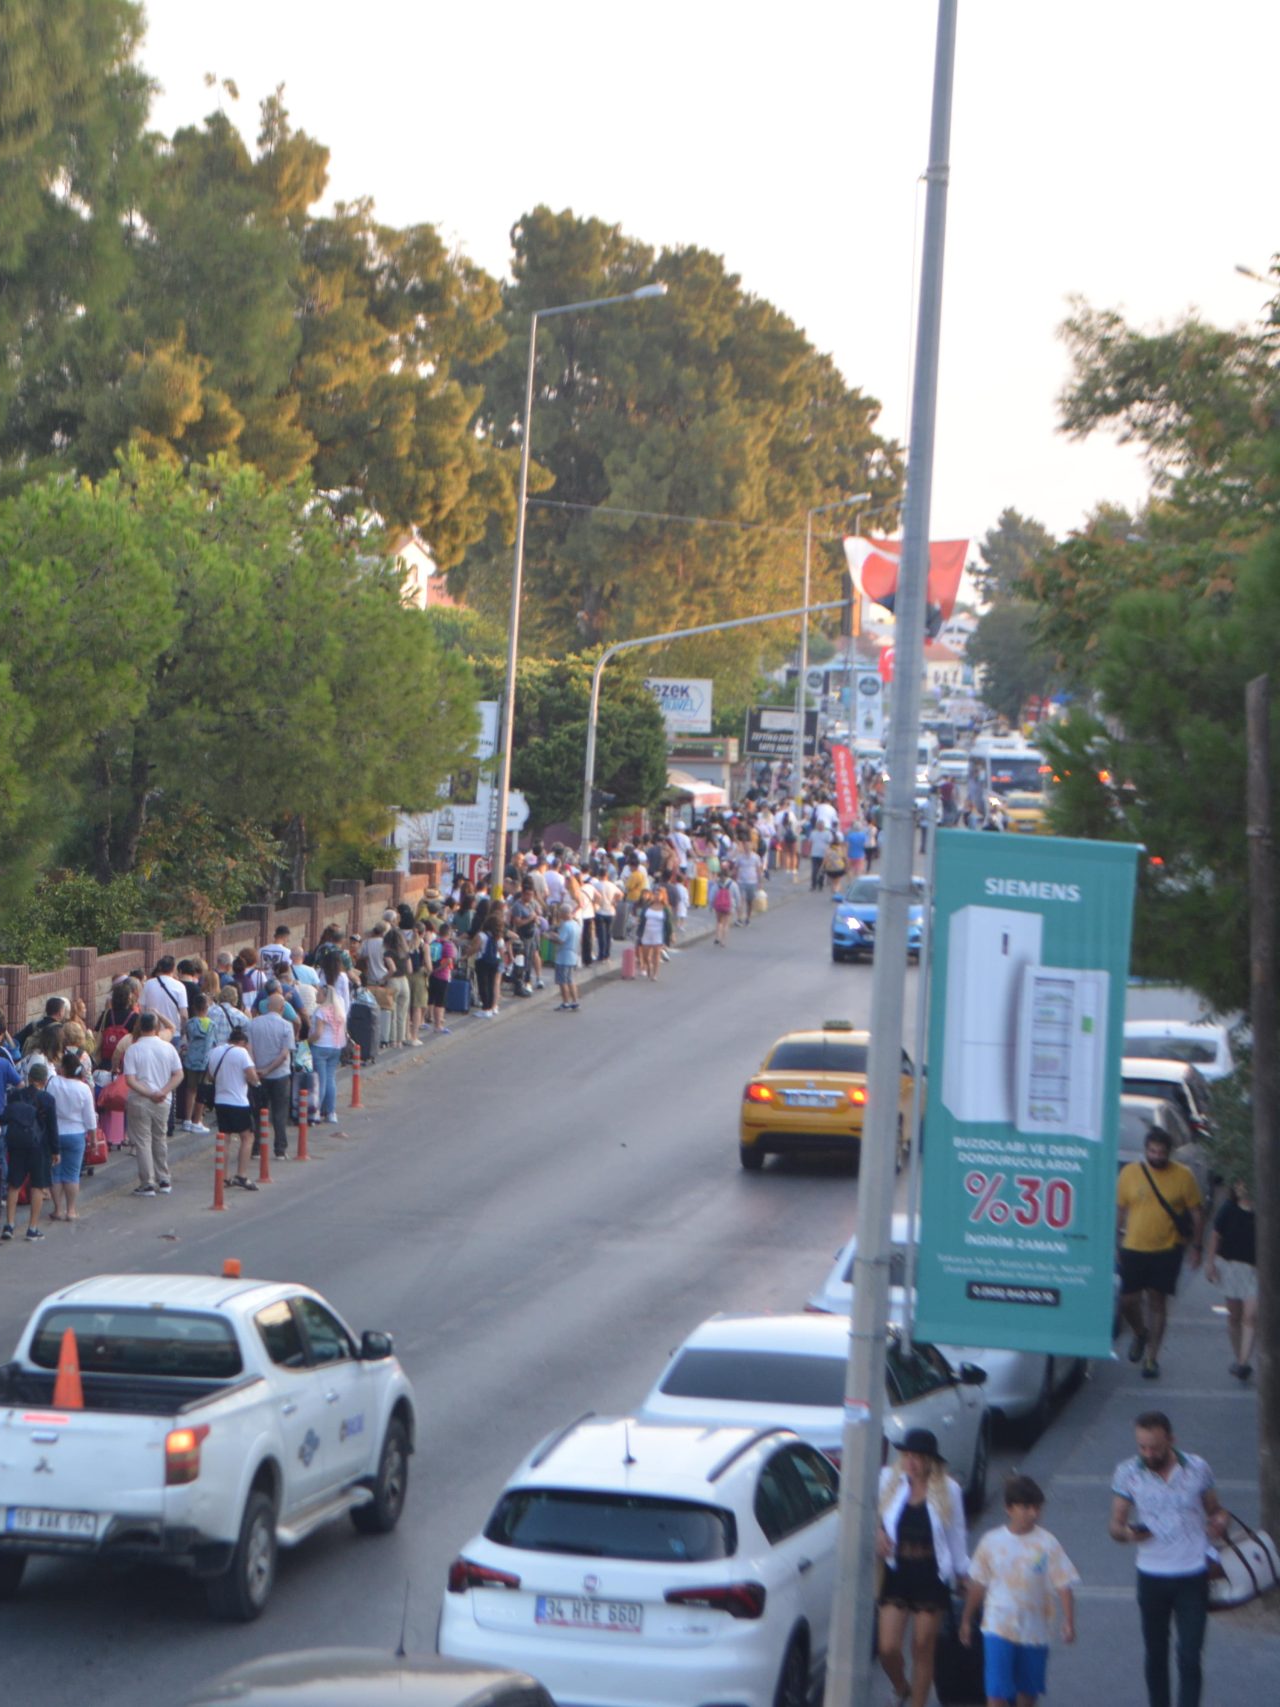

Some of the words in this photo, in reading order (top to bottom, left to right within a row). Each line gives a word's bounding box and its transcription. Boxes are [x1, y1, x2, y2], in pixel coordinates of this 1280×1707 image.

[984, 877, 1081, 902] SIEMENS
[957, 1152, 1083, 1173] DONDURUCULARDA
[1030, 1143, 1046, 1155] VE
[1049, 1144, 1089, 1159] DERİN
[964, 1170, 1074, 1231] %30
[547, 1600, 564, 1618] 34
[608, 1604, 637, 1624] 660
